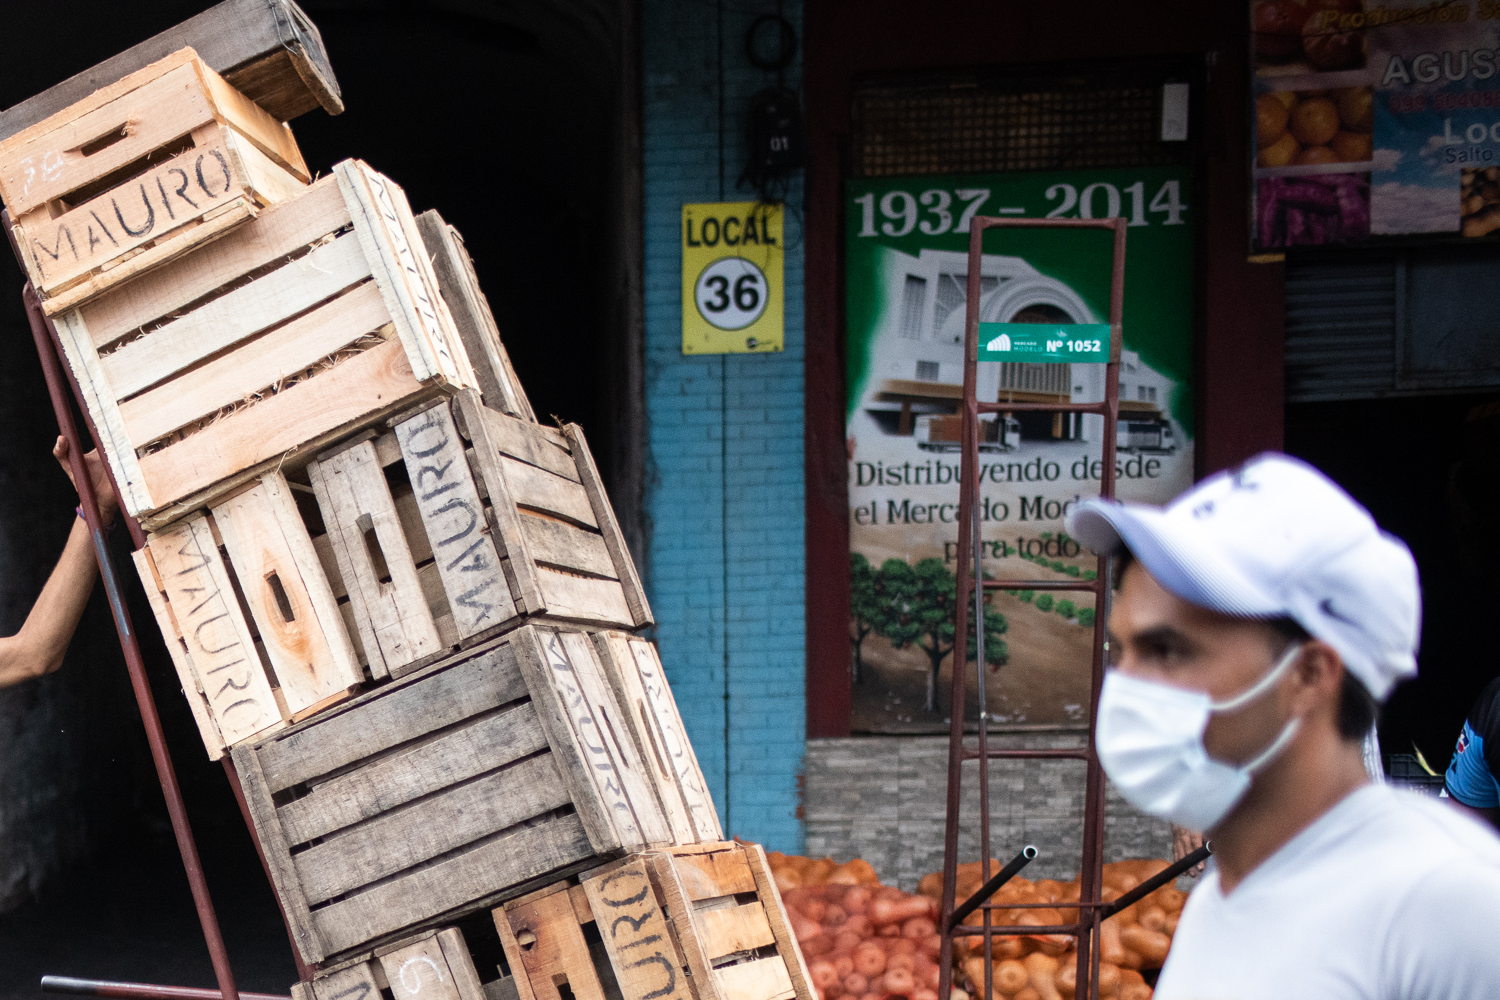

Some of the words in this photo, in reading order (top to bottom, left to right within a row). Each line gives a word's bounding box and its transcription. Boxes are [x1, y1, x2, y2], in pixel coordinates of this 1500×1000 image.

[1382, 49, 1500, 86] AGUS
[1445, 146, 1493, 163] Salto
[29, 149, 232, 280] MAURO
[854, 188, 991, 238] 1937
[1044, 180, 1188, 228] 2014
[686, 215, 777, 247] LOCAL
[703, 274, 760, 313] 36
[1066, 340, 1101, 352] 1052
[1070, 455, 1161, 480] desde
[404, 419, 502, 629] MAURO
[854, 500, 878, 525] el
[943, 534, 1011, 564] pra
[1017, 532, 1081, 558] todo
[174, 527, 262, 724] MAURO
